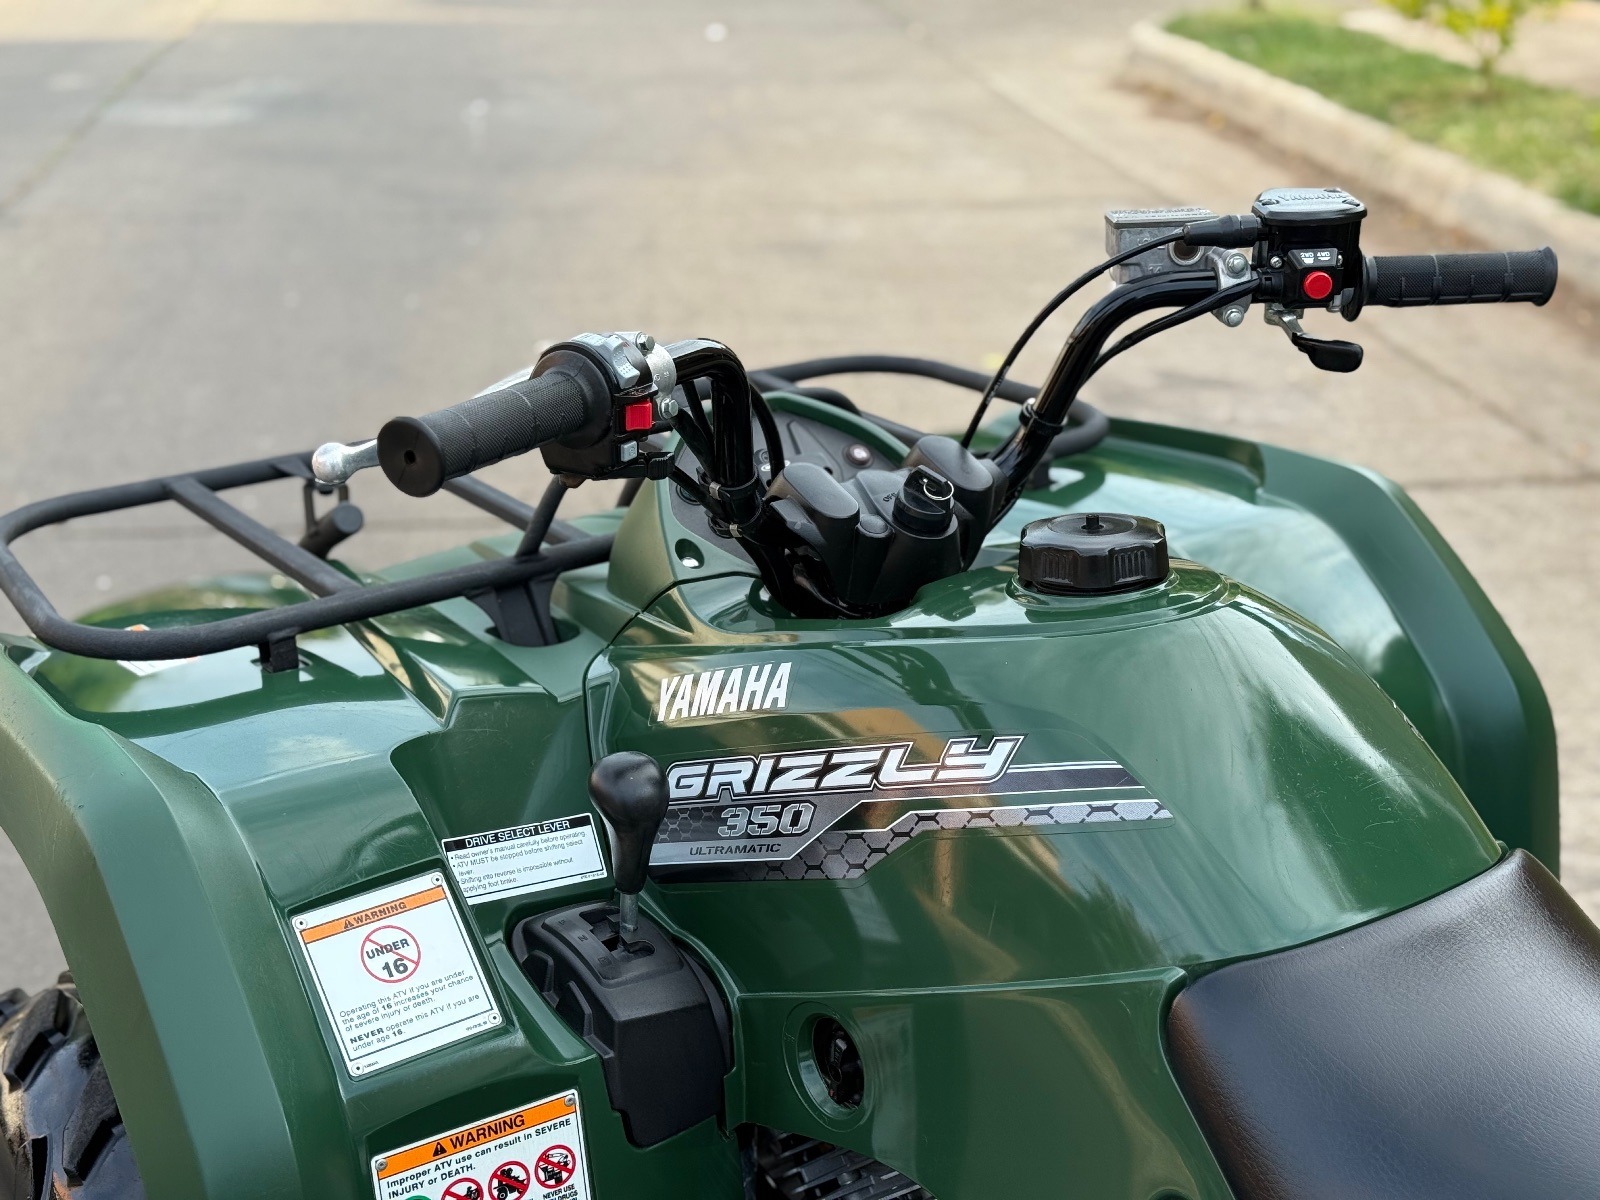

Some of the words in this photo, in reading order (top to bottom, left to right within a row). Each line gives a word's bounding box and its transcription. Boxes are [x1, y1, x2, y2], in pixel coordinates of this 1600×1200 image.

[656, 662, 792, 722] YAMAHA
[667, 737, 1022, 803] GRIZZLY
[465, 833, 497, 848] DRIVE
[498, 827, 536, 841] SELECT
[537, 820, 571, 834] LEVER
[717, 803, 813, 837] 350
[454, 851, 470, 860] Read
[470, 848, 494, 858] owner's
[494, 843, 516, 853] manual
[540, 835, 559, 844] before
[559, 831, 586, 841] operating
[456, 861, 469, 869] ATV
[470, 857, 489, 866] MUST
[499, 850, 524, 860] stopped
[524, 846, 543, 855] before
[544, 842, 566, 852] shifting
[565, 839, 583, 847] select
[688, 843, 782, 857] ULTRAMATIC
[458, 869, 474, 877] lever.
[460, 876, 482, 885] Shifting
[494, 869, 516, 878] reverse
[522, 861, 553, 873] impossible
[552, 857, 574, 866] without
[462, 883, 487, 893] applying
[488, 879, 500, 887] foot
[500, 877, 519, 885] brake.
[352, 901, 407, 925] WARNING
[365, 938, 410, 959] UNDER
[381, 957, 409, 978] 16
[339, 1001, 377, 1018] Operating
[377, 995, 392, 1005] this
[392, 988, 407, 1000] ATV
[408, 986, 415, 994] if
[415, 982, 430, 992] you
[430, 977, 443, 986] are
[444, 969, 465, 981] under
[341, 1016, 355, 1025] the
[356, 1011, 371, 1020] age
[372, 1006, 380, 1015] of
[381, 1002, 393, 1011] 16
[393, 991, 430, 1007] increases
[430, 984, 447, 996] your
[447, 975, 474, 988] chance
[345, 1024, 353, 1032] of
[354, 1016, 380, 1029] severe
[380, 1008, 401, 1020] injury
[403, 1004, 411, 1012] or
[412, 996, 436, 1009] death.
[349, 1027, 385, 1044] NEVER
[385, 1017, 414, 1032] operate
[415, 1011, 429, 1021] this
[430, 1005, 445, 1016] ATV
[445, 1002, 452, 1010] if
[452, 999, 467, 1010] you
[467, 994, 480, 1003] are
[352, 1039, 375, 1052] under
[376, 1034, 391, 1044] age
[391, 1028, 406, 1037] 16.
[449, 1114, 526, 1150] WARNING
[386, 1168, 432, 1189] Improper
[434, 1158, 453, 1173] ATV
[455, 1153, 472, 1165] use
[474, 1146, 492, 1158] can
[494, 1135, 522, 1152] result
[523, 1131, 533, 1141] in
[534, 1117, 572, 1137] SEVERE
[388, 1180, 425, 1200] INJURY
[427, 1176, 438, 1186] or
[440, 1163, 476, 1181] DEATH.
[543, 1189, 563, 1200] NEVER
[563, 1183, 576, 1193] USE
[558, 1190, 579, 1200] DRUGS
